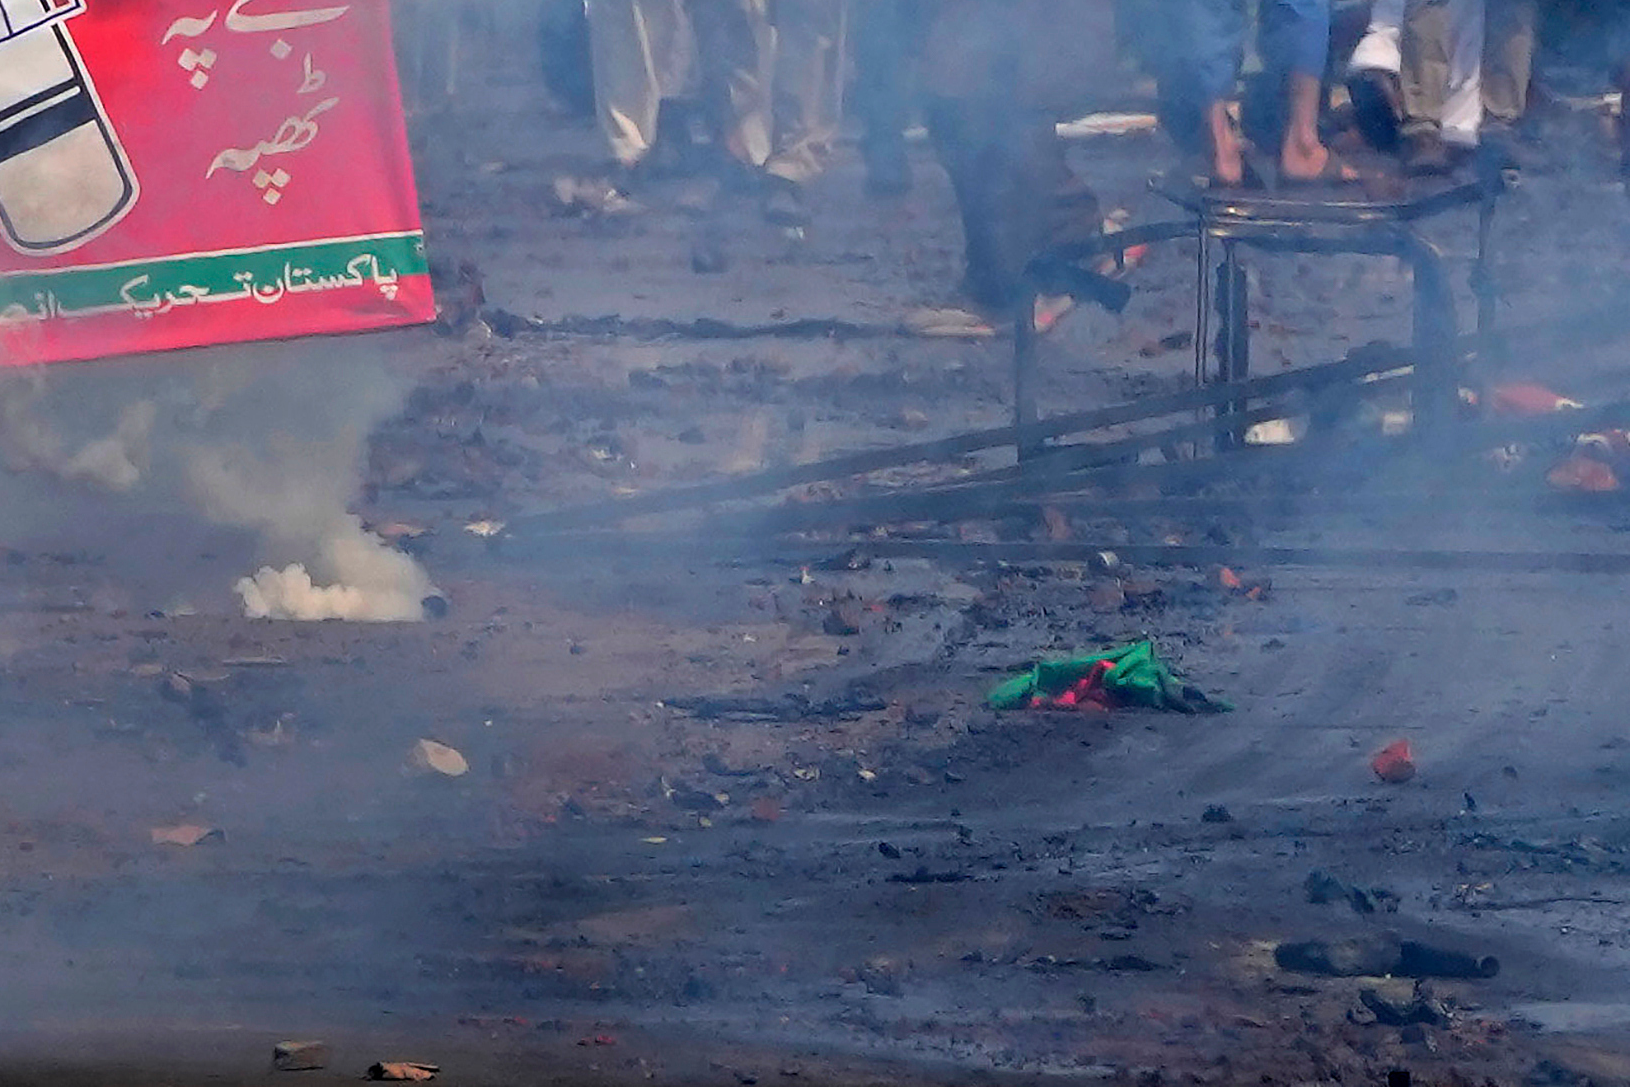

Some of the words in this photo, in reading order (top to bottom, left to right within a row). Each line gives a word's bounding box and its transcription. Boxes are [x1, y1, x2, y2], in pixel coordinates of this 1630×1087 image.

[161, 9, 218, 90] پہ
[58, 270, 254, 319] تحریک
[253, 253, 399, 302] پاکستان
